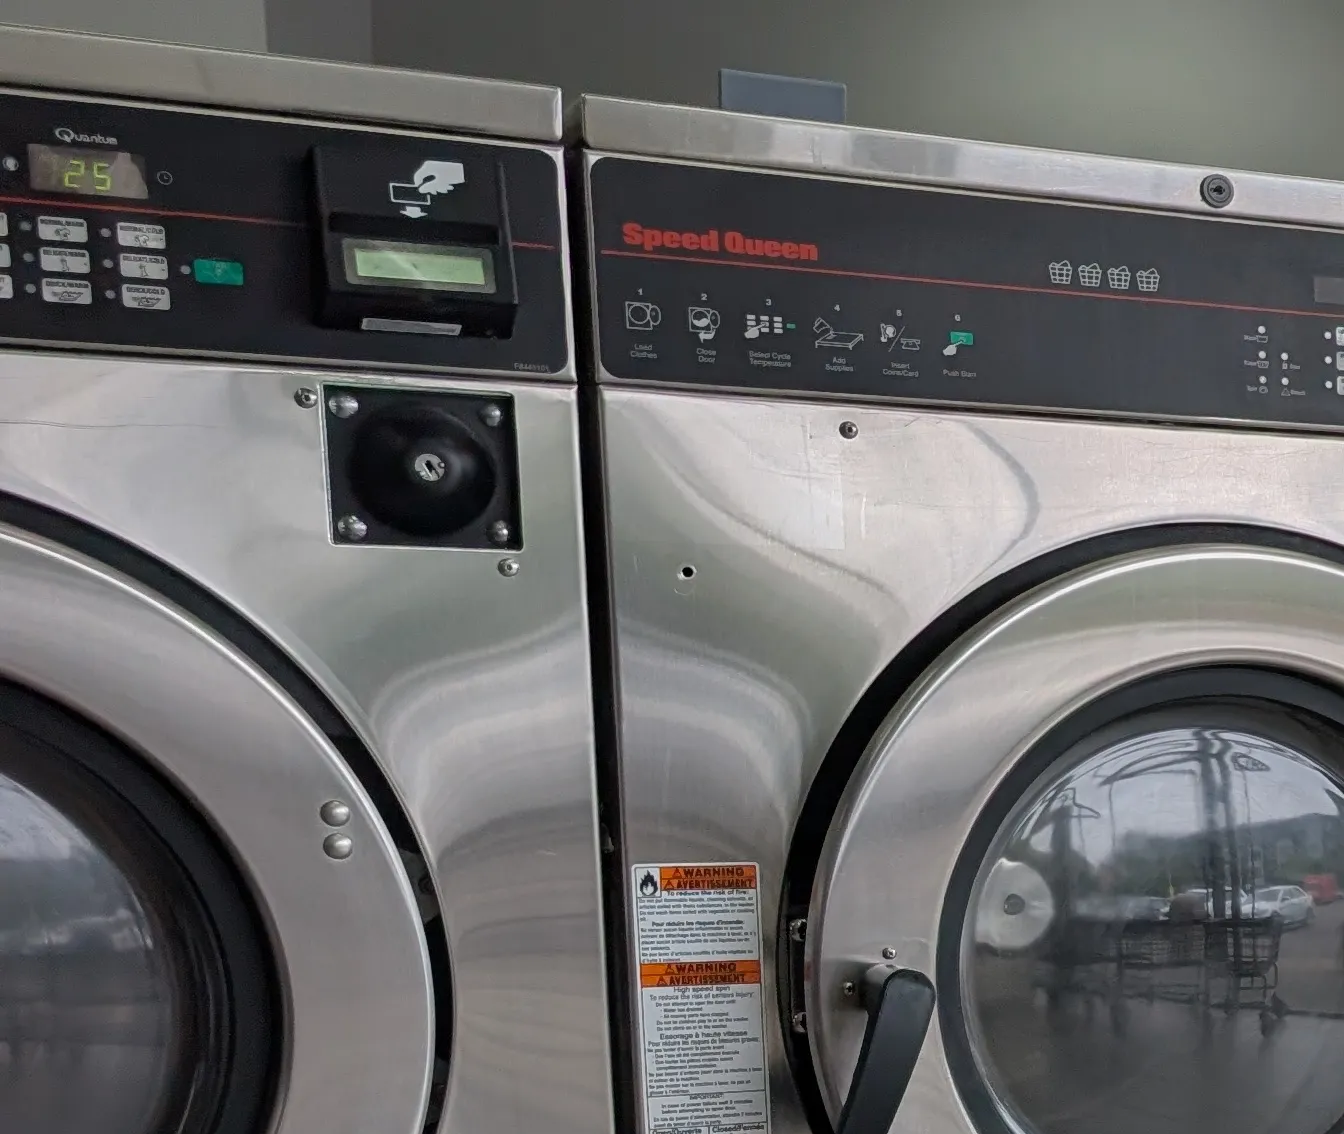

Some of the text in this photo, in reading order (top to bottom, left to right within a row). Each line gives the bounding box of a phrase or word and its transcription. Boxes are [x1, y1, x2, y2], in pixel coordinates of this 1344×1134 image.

[55, 127, 118, 145] Quantum
[64, 160, 111, 191] 25
[622, 223, 818, 261] Speed Queen
[701, 293, 708, 301] 2
[630, 351, 657, 359] Clothes
[698, 355, 715, 363] Door
[749, 350, 791, 360] Select Cycle
[825, 364, 854, 373] Supplies
[943, 369, 960, 377] Push
[684, 868, 744, 877] WARNING
[677, 879, 754, 889] AVERTISSEMENT
[675, 963, 737, 974] WARNING
[670, 974, 745, 986] AVERTISSEMENT
